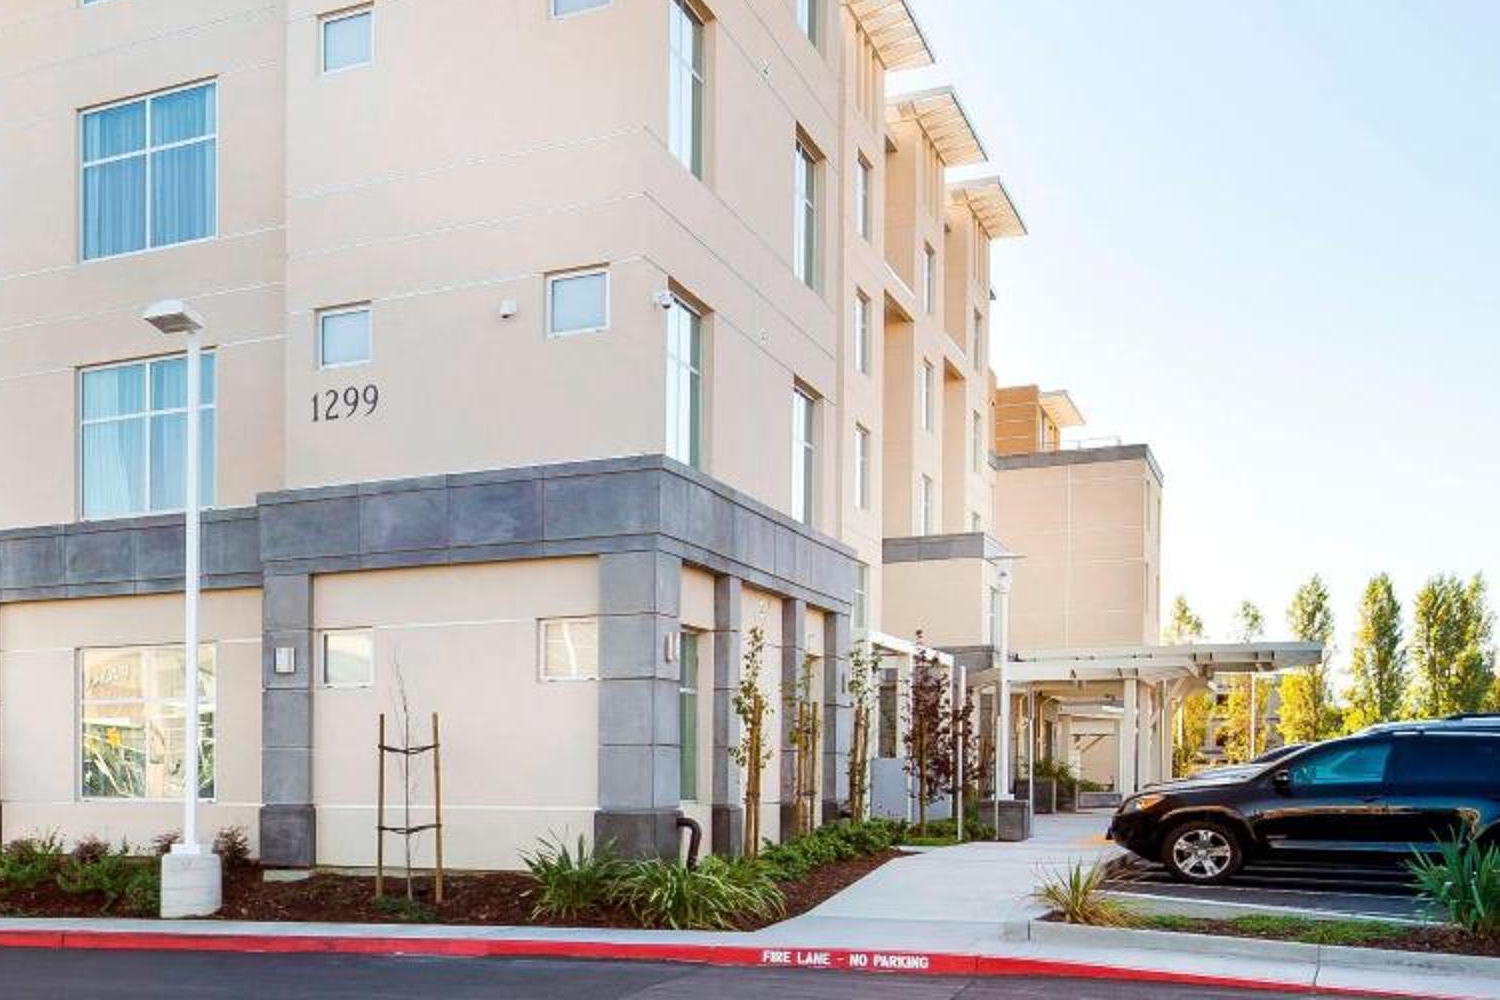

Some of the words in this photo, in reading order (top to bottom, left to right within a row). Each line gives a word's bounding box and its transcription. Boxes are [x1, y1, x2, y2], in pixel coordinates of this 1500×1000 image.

[311, 384, 379, 422] 1299
[762, 950, 791, 963] FIRE
[797, 952, 831, 965] LANE
[850, 953, 868, 967] NO
[873, 955, 929, 969] PARKING
